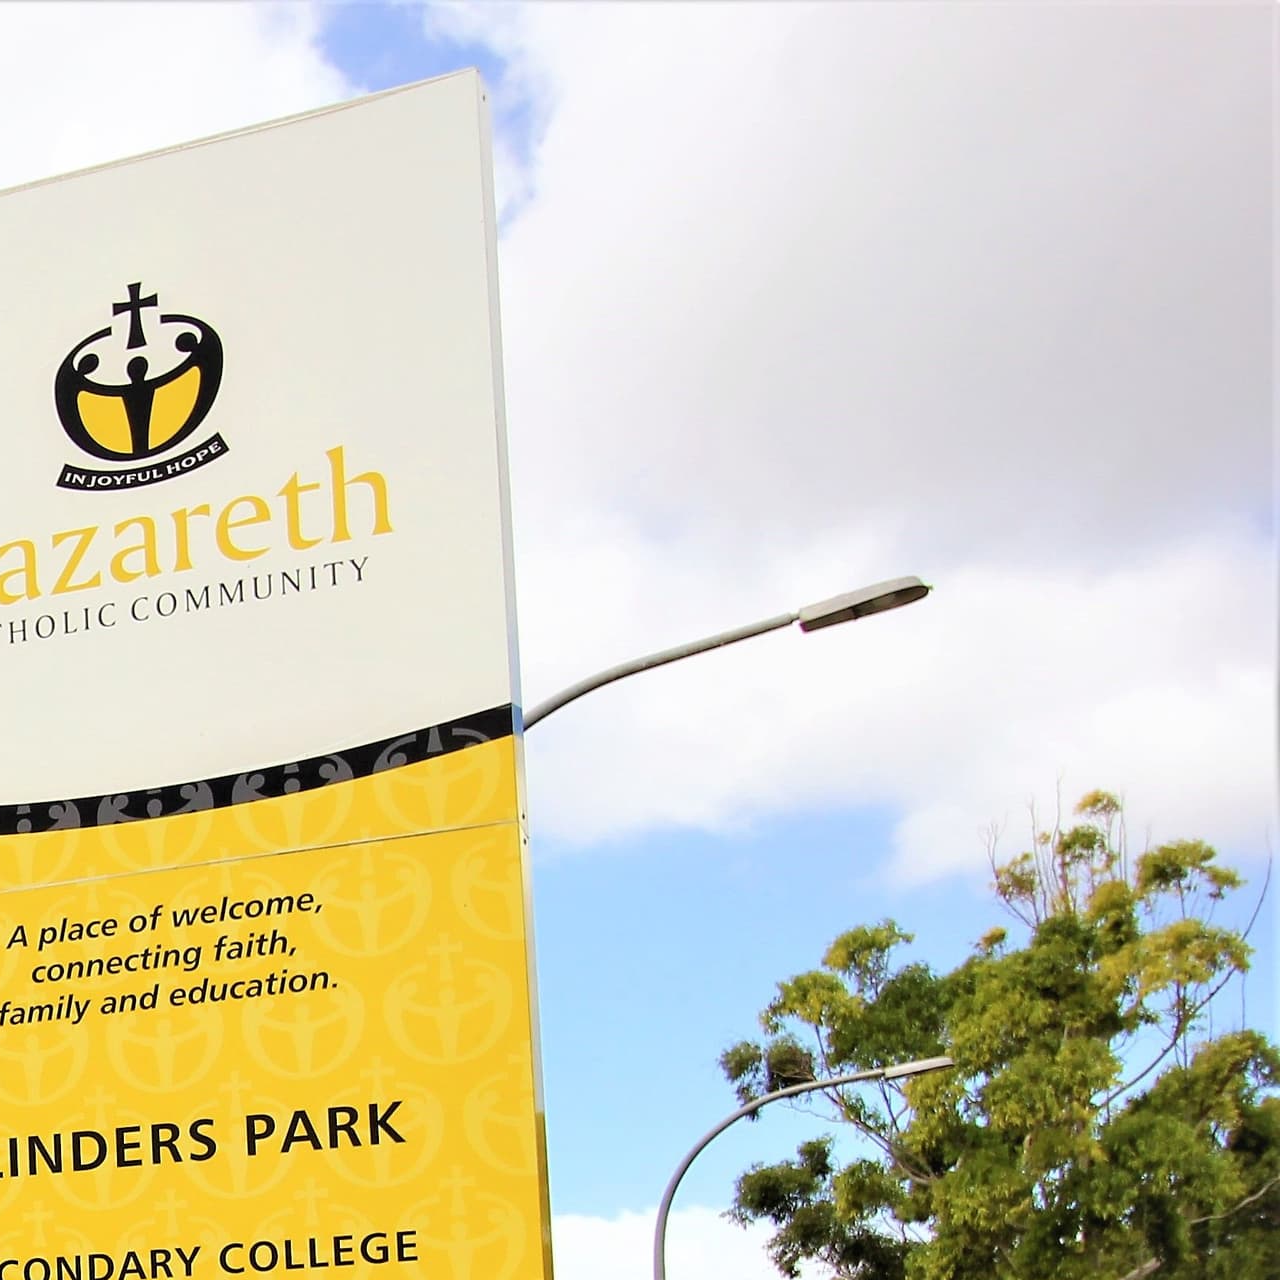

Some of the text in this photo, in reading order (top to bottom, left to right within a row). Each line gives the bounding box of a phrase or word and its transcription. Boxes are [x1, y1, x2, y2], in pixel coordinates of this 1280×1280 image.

[64, 441, 222, 487] IN JOYFUL HOPE
[131, 556, 368, 621] COMMUNITY
[6, 893, 322, 952] A place of welcome,
[31, 929, 297, 984] connecting faith,
[100, 983, 160, 1015] and
[169, 969, 338, 1007] education.
[245, 1100, 406, 1156] PARK
[219, 1230, 418, 1274] COLLEGE
